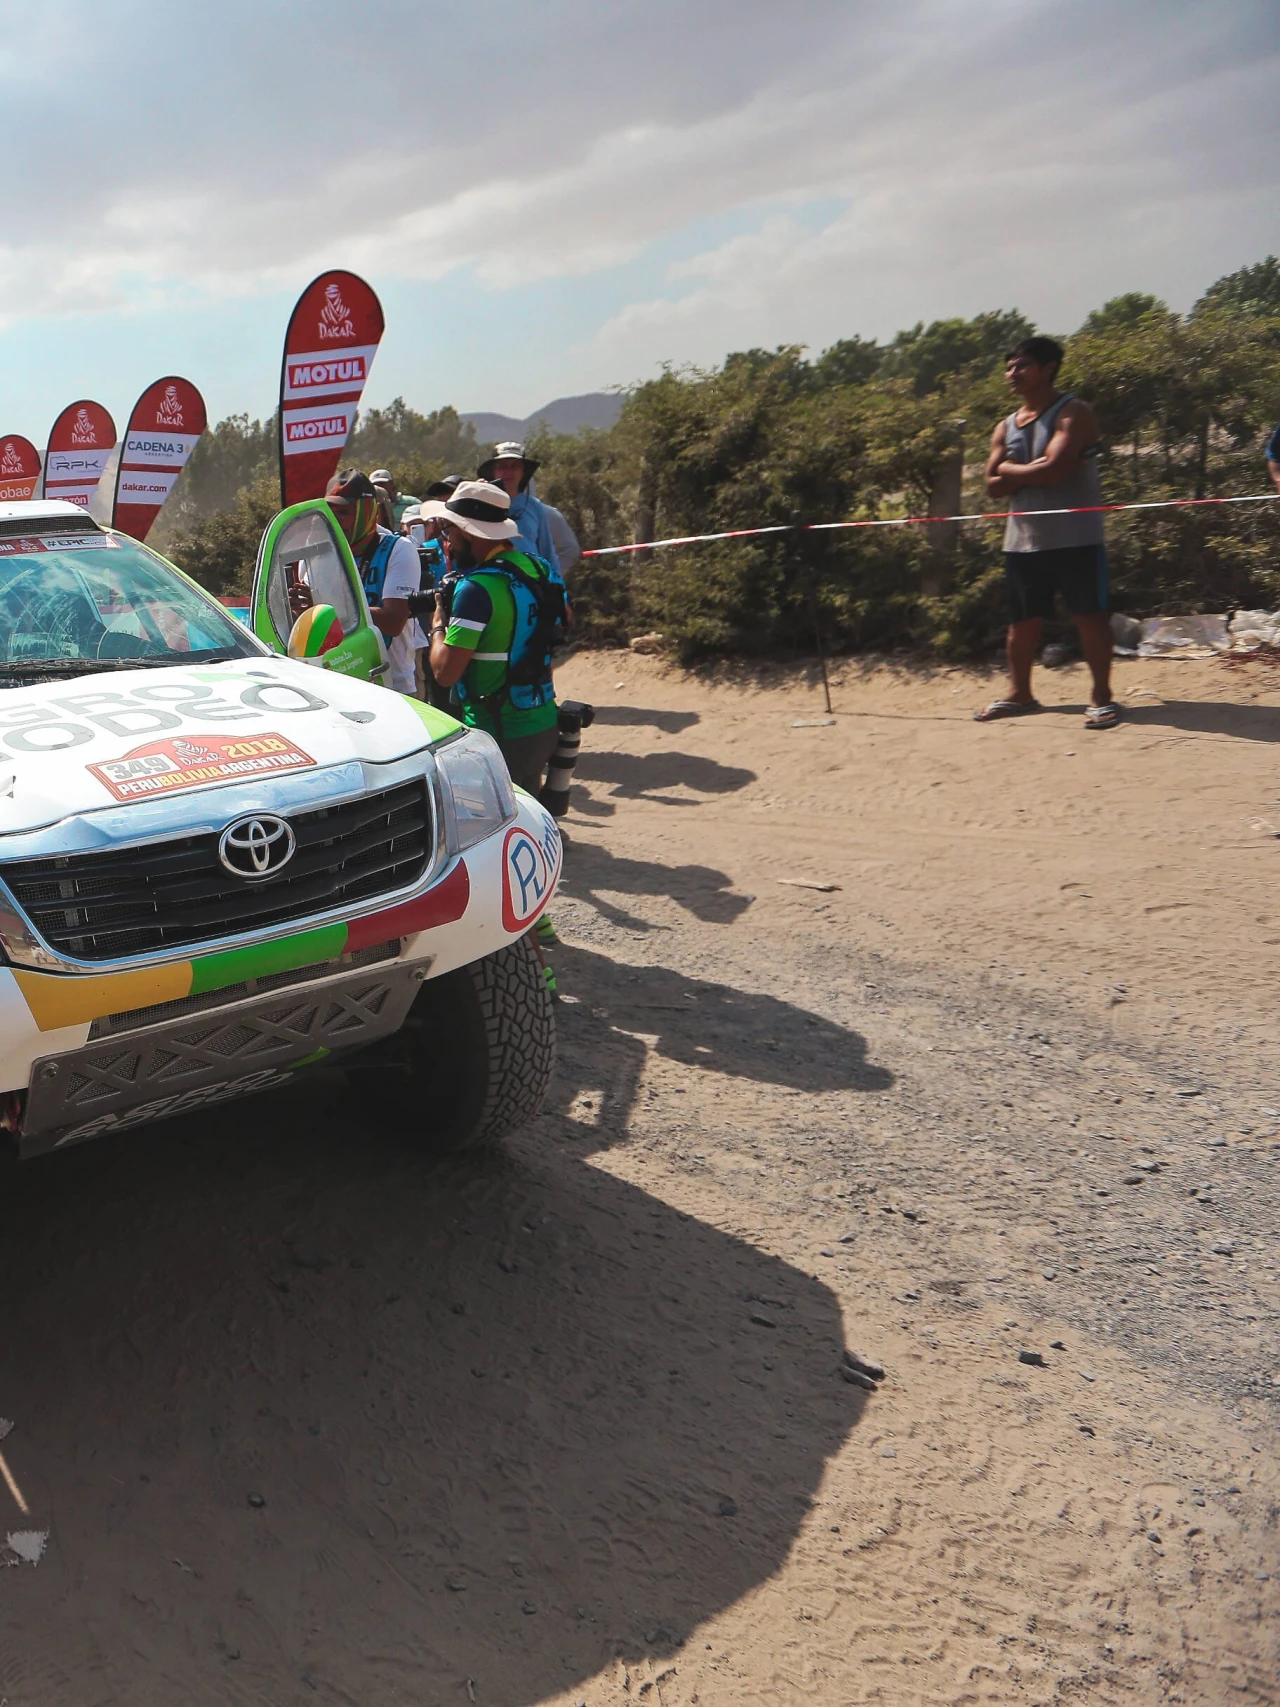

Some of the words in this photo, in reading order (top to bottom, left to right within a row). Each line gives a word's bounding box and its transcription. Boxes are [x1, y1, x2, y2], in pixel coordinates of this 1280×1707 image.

[318, 320, 357, 340] DAKAR
[292, 358, 365, 386] MOTUL
[156, 411, 184, 427] DAKAR
[289, 417, 346, 440] MOTUL
[71, 432, 98, 444] DAKAR
[127, 441, 175, 453] CADENA
[176, 443, 184, 454] 3
[1, 464, 25, 475] DAKAR
[55, 459, 100, 471] RPK
[122, 483, 168, 493] dakar.com
[220, 737, 289, 759] 2018
[106, 755, 170, 780] 349
[177, 753, 226, 767] DAKAR
